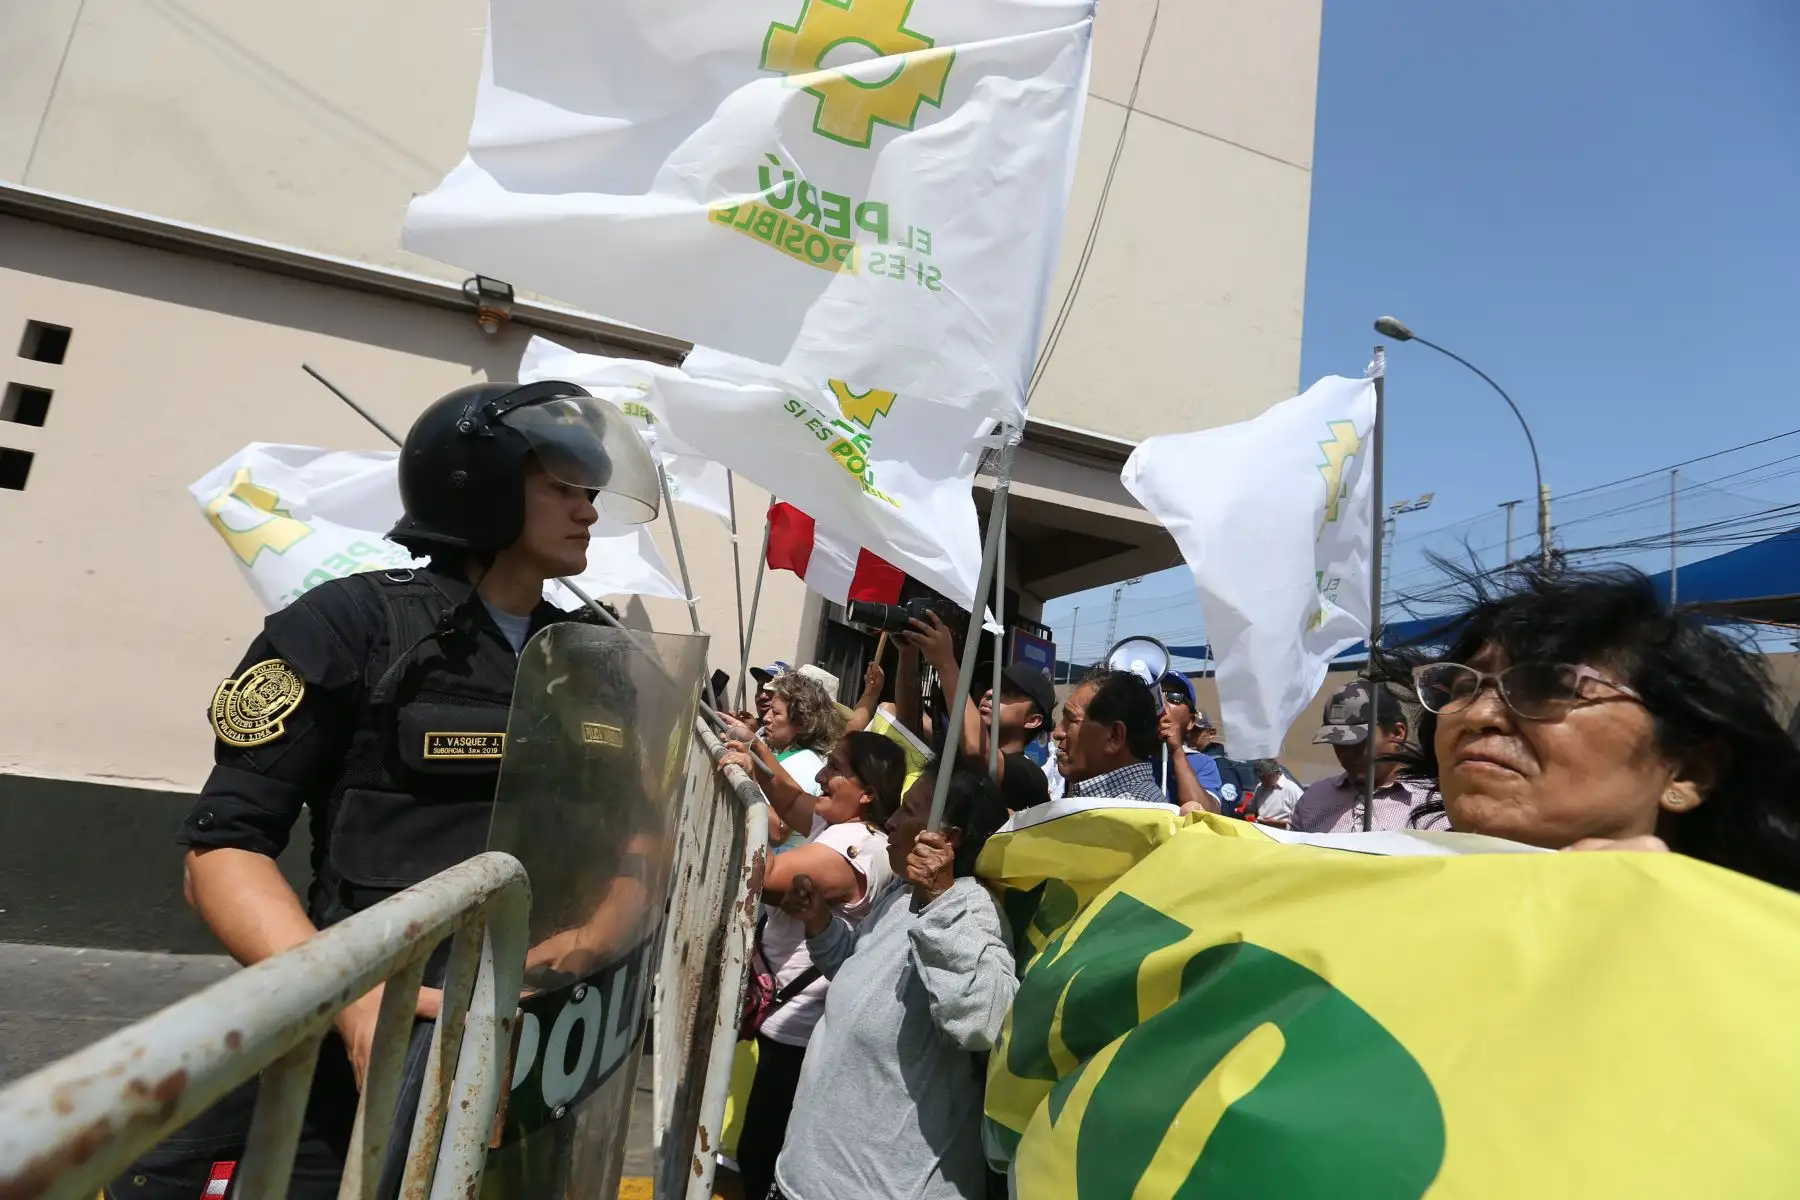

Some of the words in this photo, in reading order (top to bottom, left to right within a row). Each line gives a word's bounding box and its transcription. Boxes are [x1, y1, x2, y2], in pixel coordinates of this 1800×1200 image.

[784, 399, 807, 418] SI
[804, 418, 834, 441] ES
[253, 663, 285, 677] POLICIA
[216, 689, 230, 718] REGION
[255, 716, 270, 728] LEY
[218, 718, 246, 742] POLICIAL
[249, 728, 273, 742] LIMA
[433, 737, 441, 747] J.
[447, 737, 488, 747] VASQUEZ
[491, 738, 500, 747] J.
